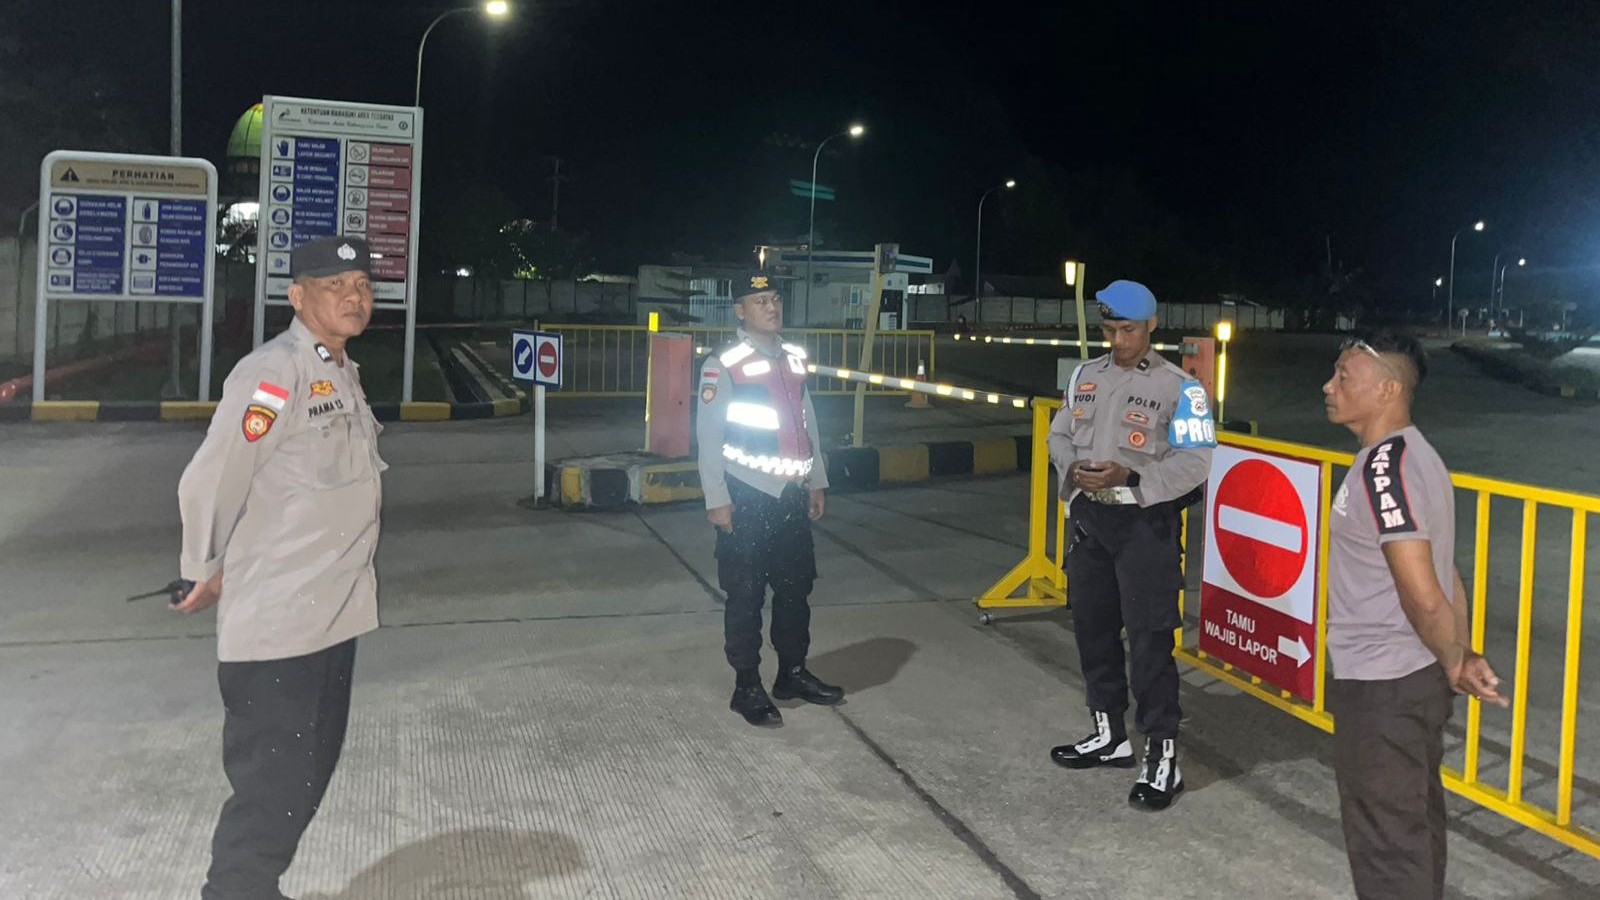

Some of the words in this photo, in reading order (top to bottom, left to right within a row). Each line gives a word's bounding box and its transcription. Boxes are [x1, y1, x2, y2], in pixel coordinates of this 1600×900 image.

[112, 169, 175, 181] PERHATIAN
[308, 401, 335, 418] PRAMA
[1127, 395, 1162, 411] POLRI
[1173, 418, 1217, 444] PRO
[1371, 443, 1406, 529] SATPAM
[1225, 608, 1256, 634] TAMU
[1204, 619, 1237, 647] WAJIB
[1238, 635, 1278, 665] LAPOR
